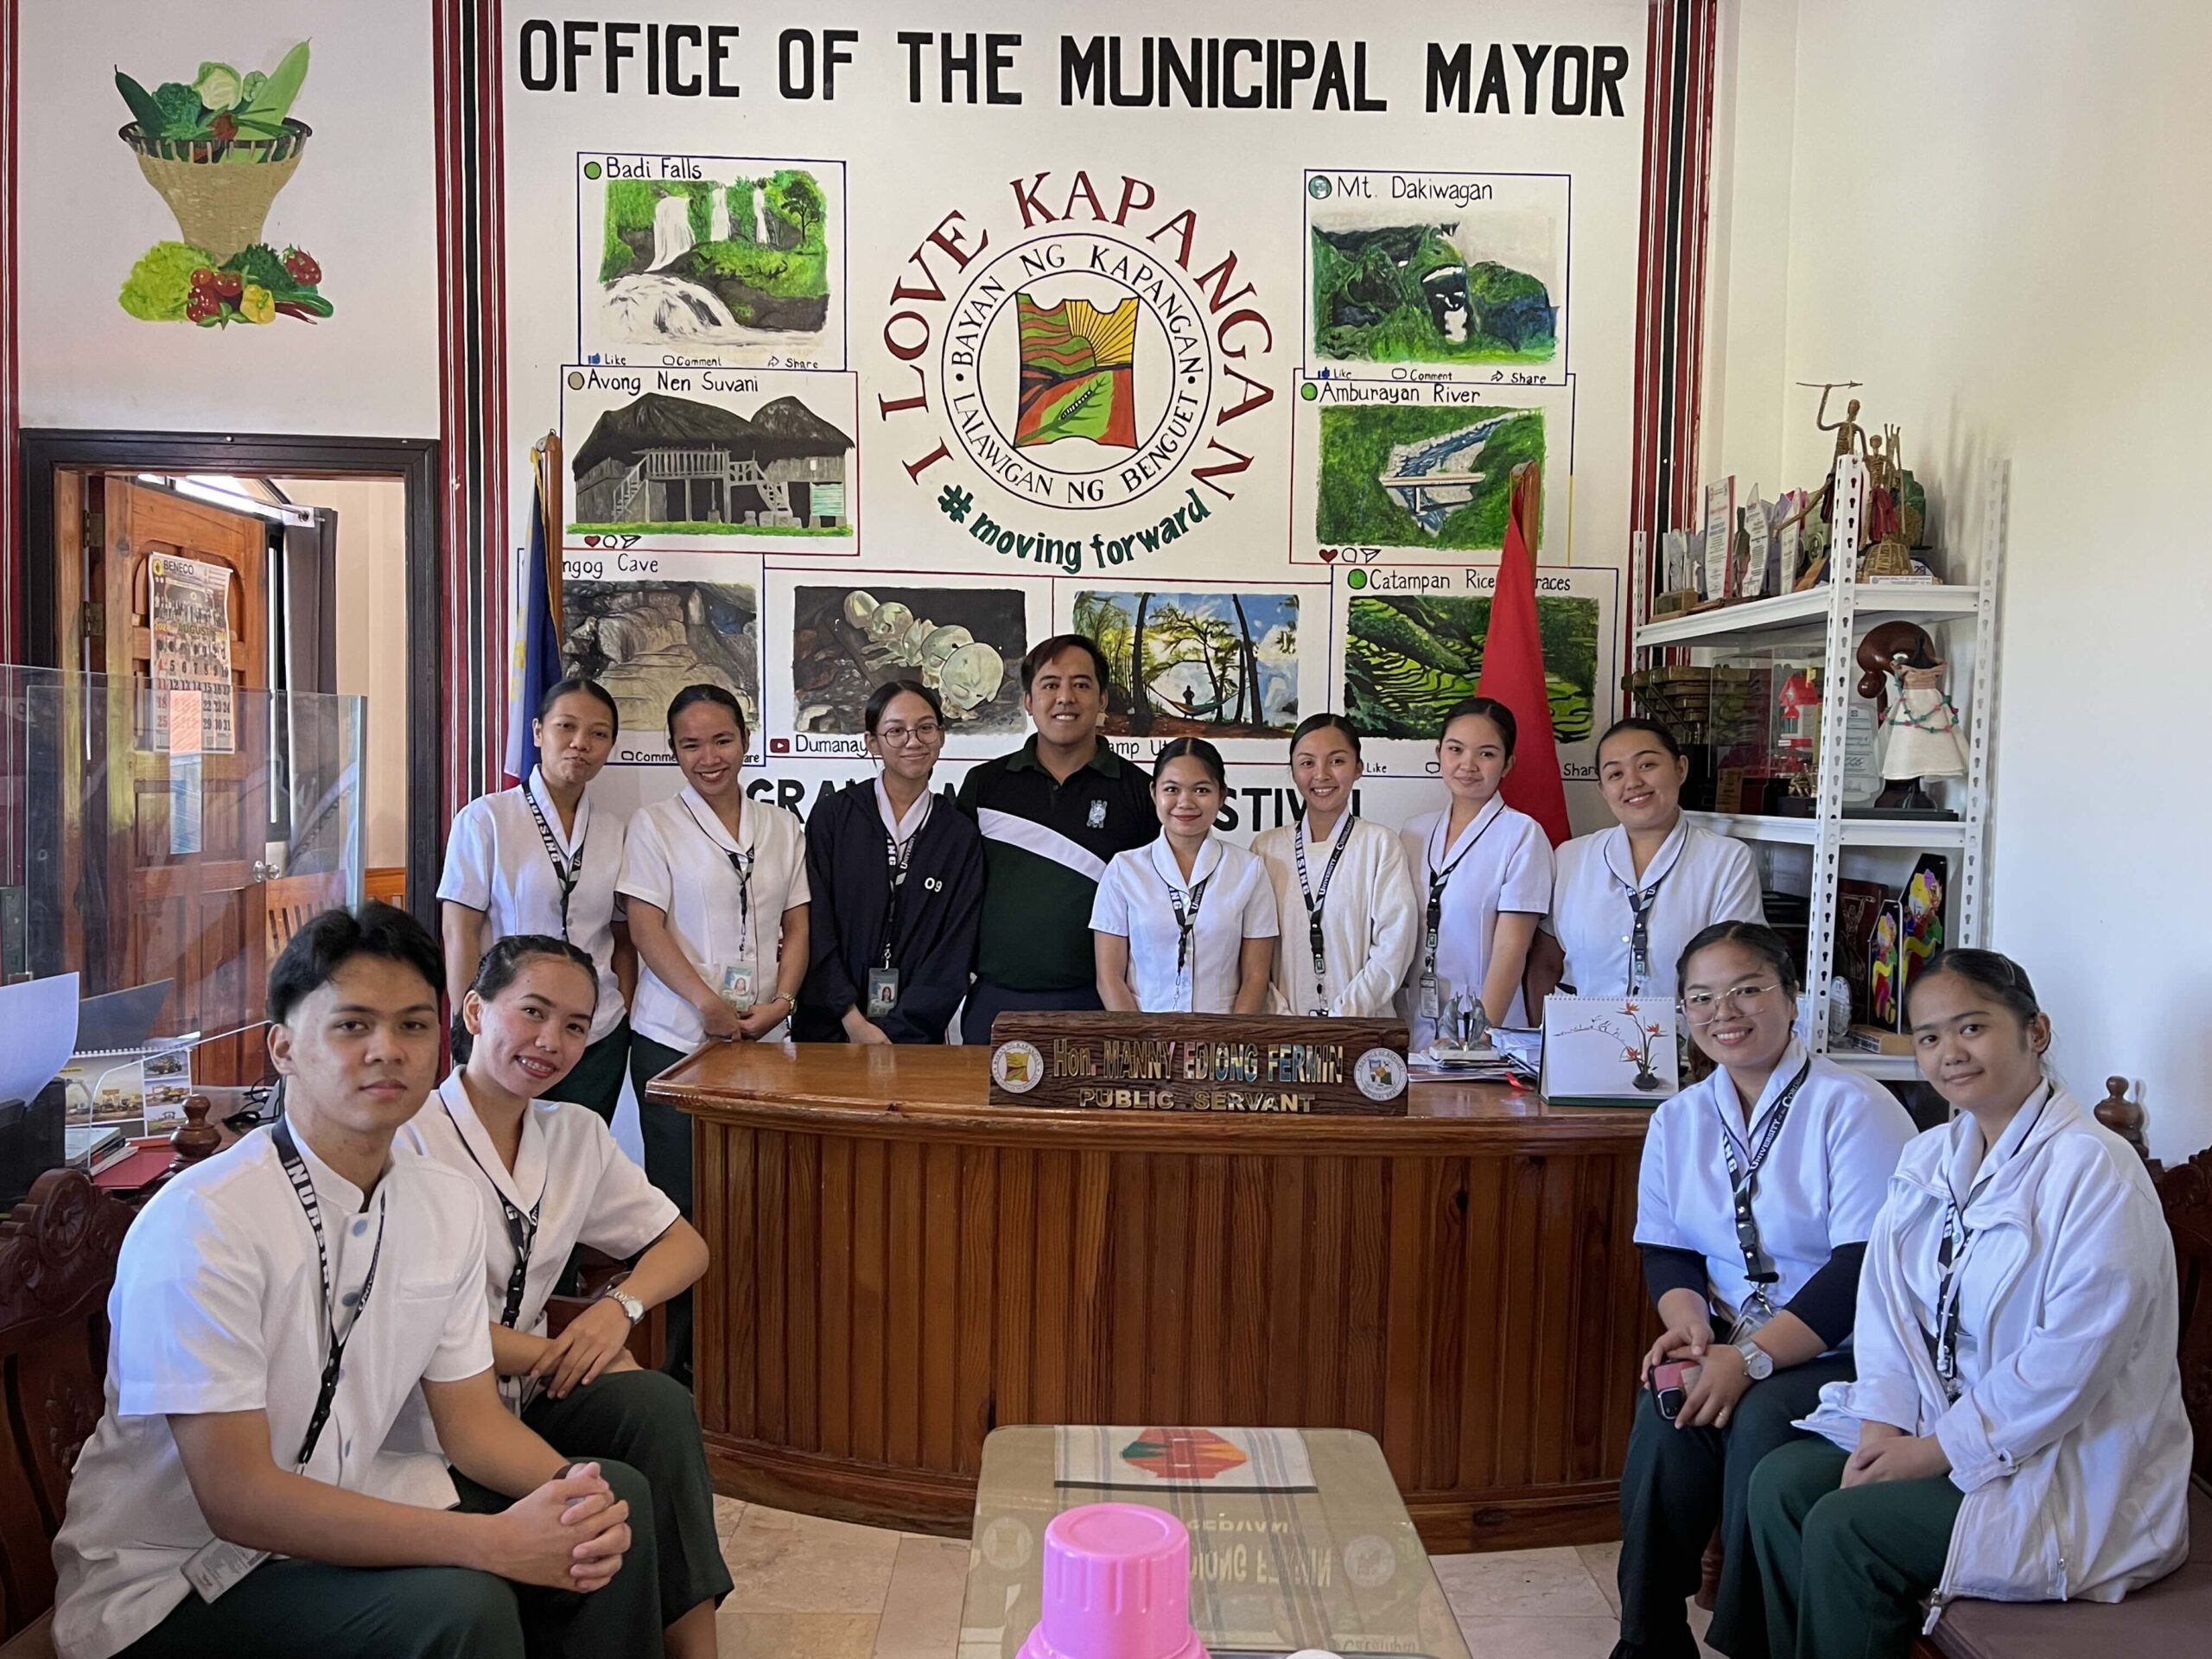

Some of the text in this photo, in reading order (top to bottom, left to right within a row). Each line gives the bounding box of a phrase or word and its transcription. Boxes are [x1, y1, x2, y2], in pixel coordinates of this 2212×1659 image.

[519, 20, 1630, 117] OFFICE OF THE MUNICIPAL MAYOR
[607, 157, 702, 179] Badi Falls
[1391, 175, 1493, 207] Dakiwagan
[951, 244, 1205, 375] BAYAN NG KAPANGAN
[878, 170, 1274, 501] I LOVE KAPANGAN
[605, 354, 818, 369] Like Comment Share
[588, 369, 759, 395] Avong Nen Suvani
[1334, 369, 1547, 384] Like Comment Share
[1319, 381, 1480, 403] Amburayan River
[953, 391, 1198, 503] LALAWIGAN NG BENGUET
[1090, 487, 1211, 568] forward
[163, 560, 194, 575] BENECO
[563, 553, 658, 579] ngog Cave
[1370, 569, 1571, 593] Catampan Rice races
[170, 678, 179, 690] 12
[636, 752, 760, 763] Comme are
[1109, 741, 1139, 759] amp
[1367, 762, 1594, 775] Like Shar
[526, 796, 561, 863] NURSING
[1295, 830, 1310, 895] NURSING
[1053, 1039, 1343, 1084] Hon. MANNY EDIONG FERMIN
[1079, 1089, 1315, 1112] PUBLIC SERVANT
[1750, 1119, 1780, 1170] UNIVERSITY
